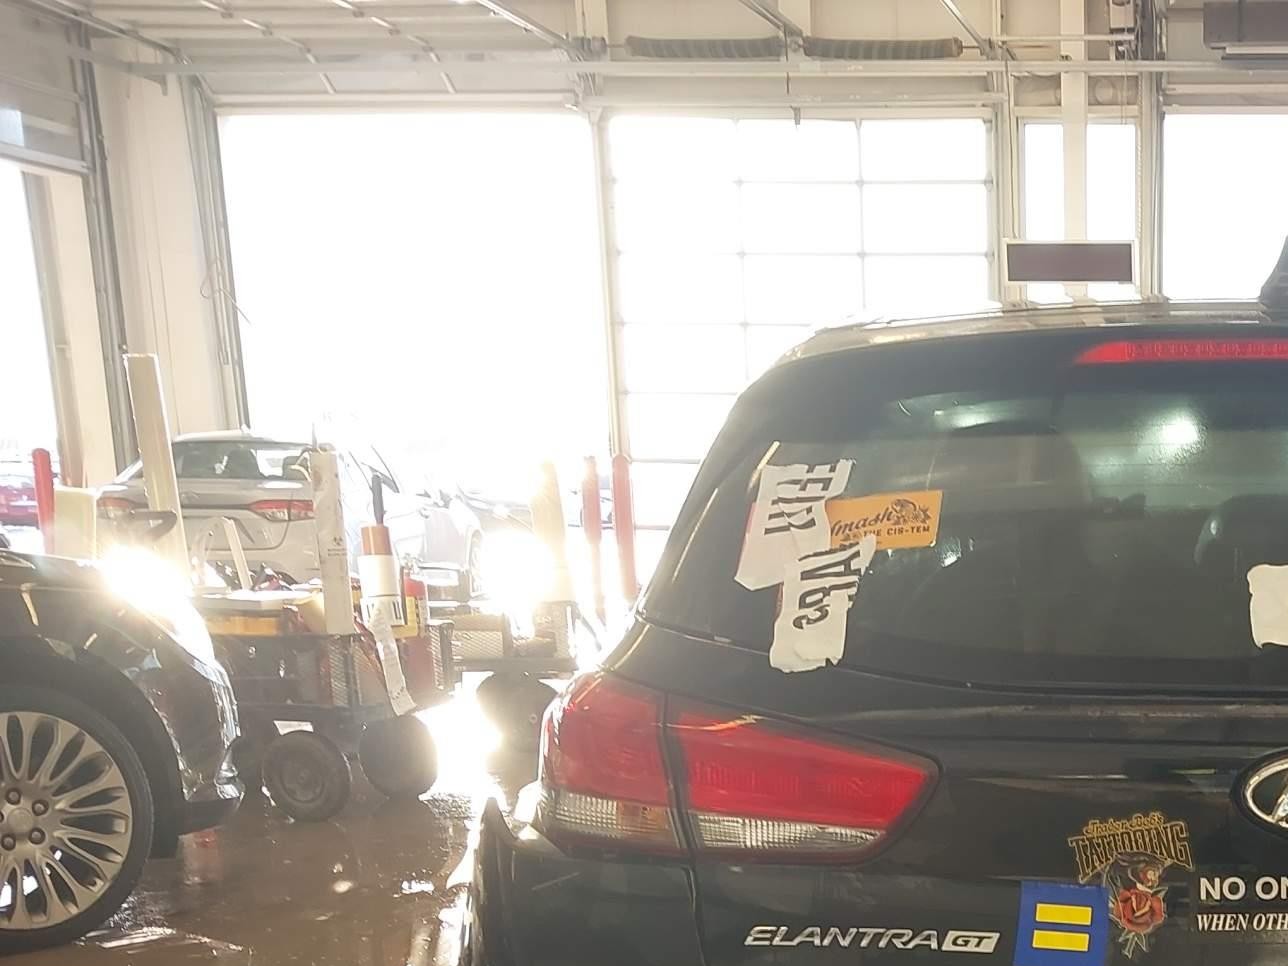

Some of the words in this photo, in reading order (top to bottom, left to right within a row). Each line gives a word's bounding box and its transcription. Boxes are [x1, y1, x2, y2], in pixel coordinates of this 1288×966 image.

[885, 524, 932, 538] CIS-TEM
[1068, 821, 1194, 884] TATTOOING
[1199, 876, 1246, 901] NO
[1197, 912, 1250, 932] WHEN
[744, 926, 939, 950] ELANTRA
[948, 933, 996, 951] GT
